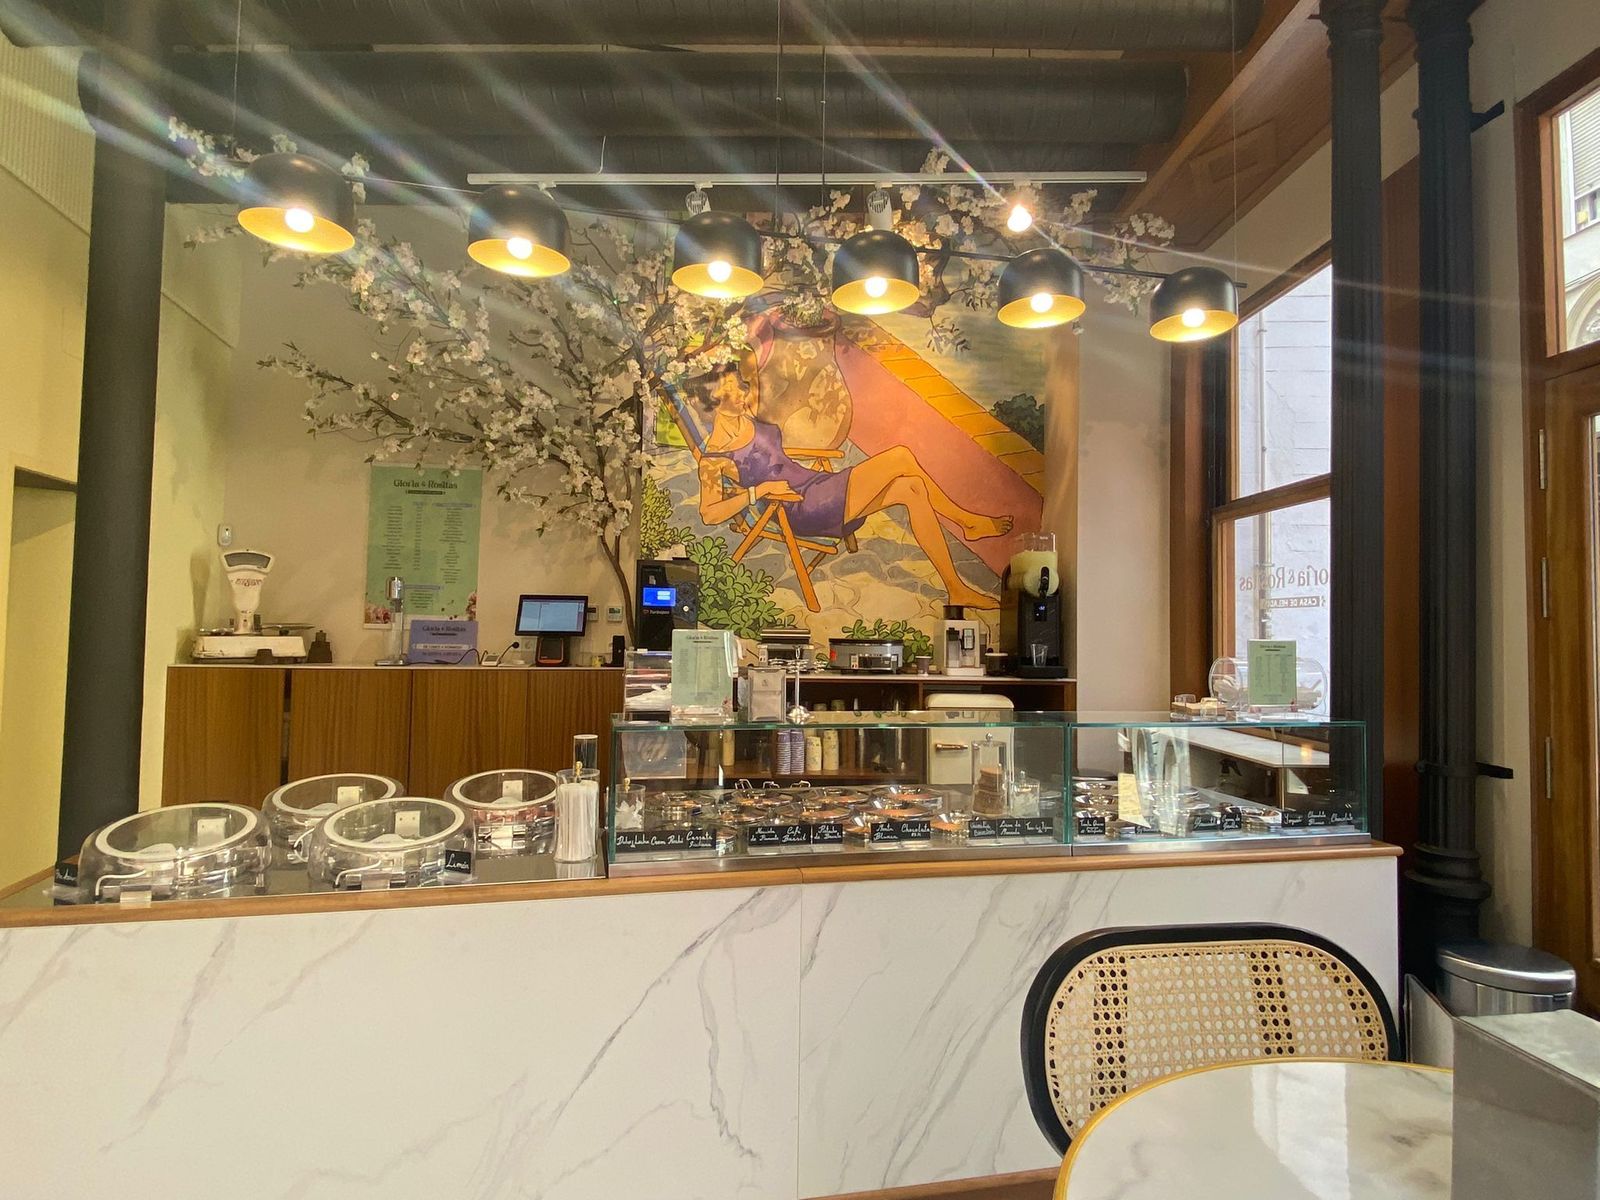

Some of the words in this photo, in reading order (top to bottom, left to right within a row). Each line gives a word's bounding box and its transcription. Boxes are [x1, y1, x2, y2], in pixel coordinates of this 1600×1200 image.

[393, 479, 420, 489] Gloria
[428, 479, 458, 489] Rositas
[901, 823, 931, 833] Chocolate
